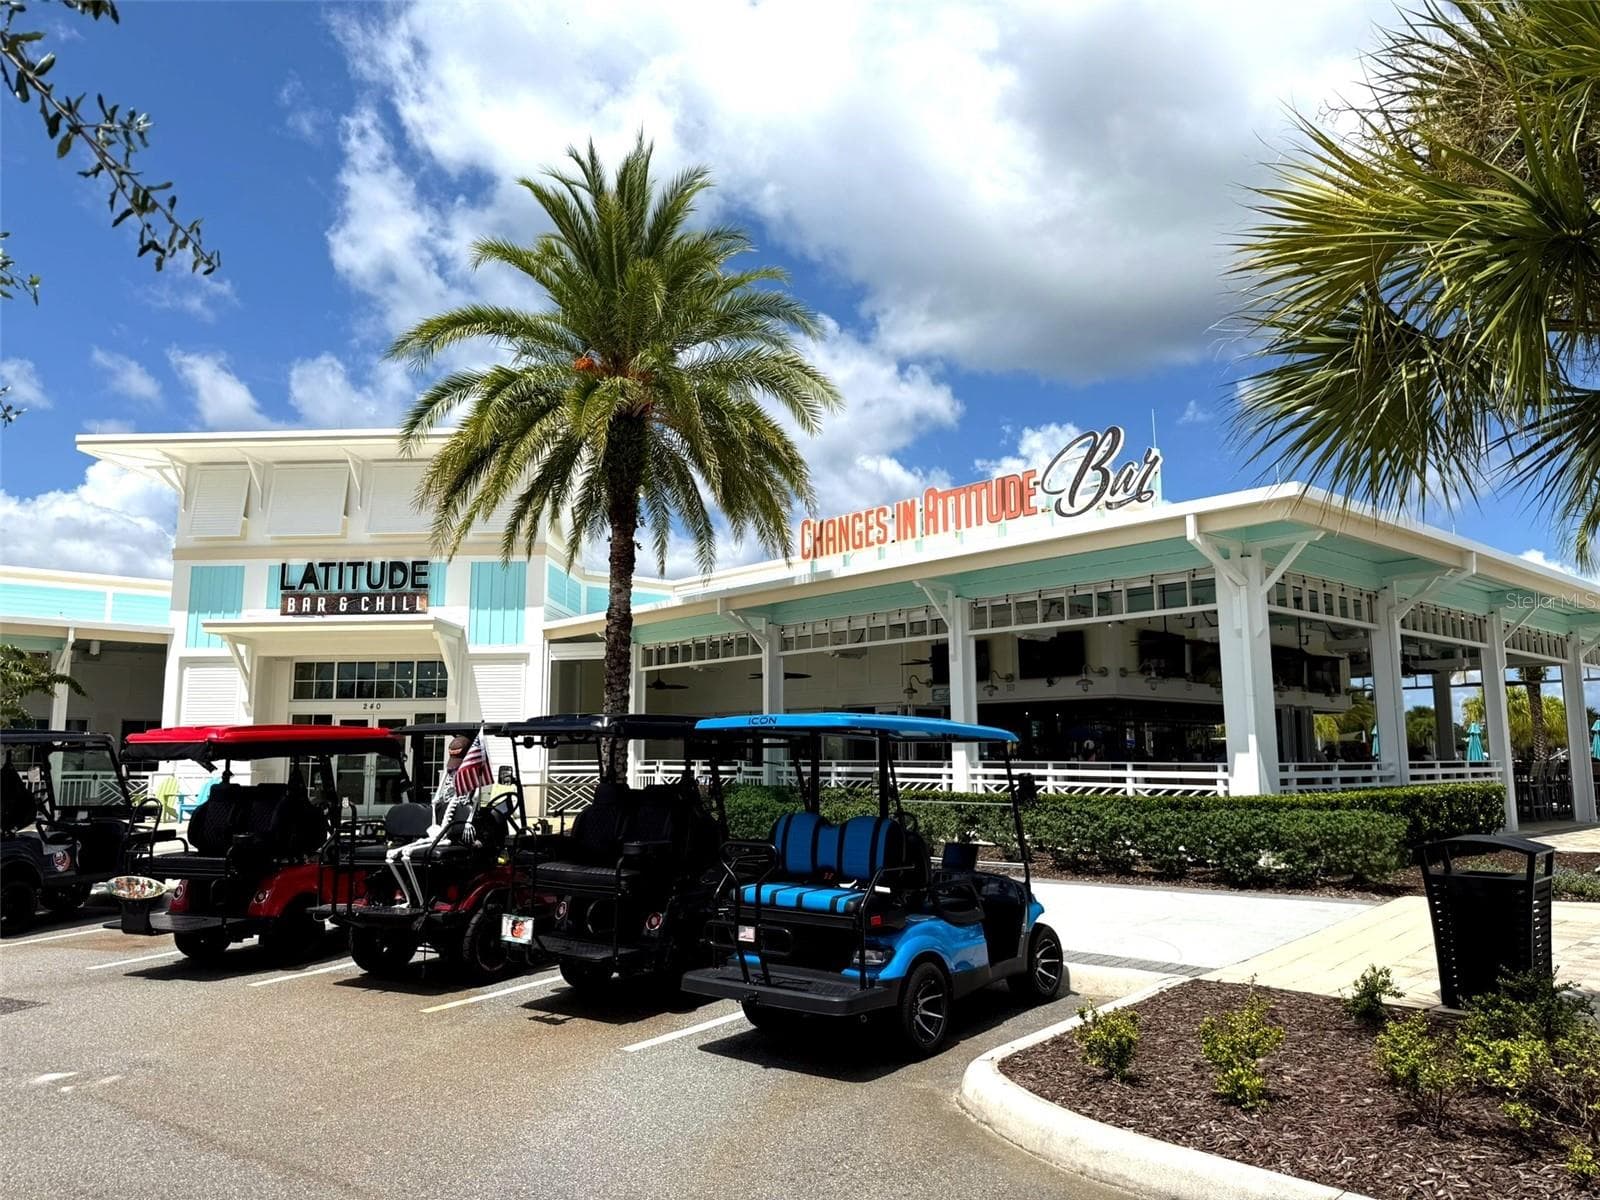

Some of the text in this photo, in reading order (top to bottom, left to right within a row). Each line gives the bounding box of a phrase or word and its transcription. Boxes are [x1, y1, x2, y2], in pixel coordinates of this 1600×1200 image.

[800, 425, 1160, 560] CHANGES IN ATTITUDE Bar
[280, 560, 429, 591] LATITUDE
[287, 596, 422, 613] BAR & CHILL
[748, 716, 777, 725] ICON
